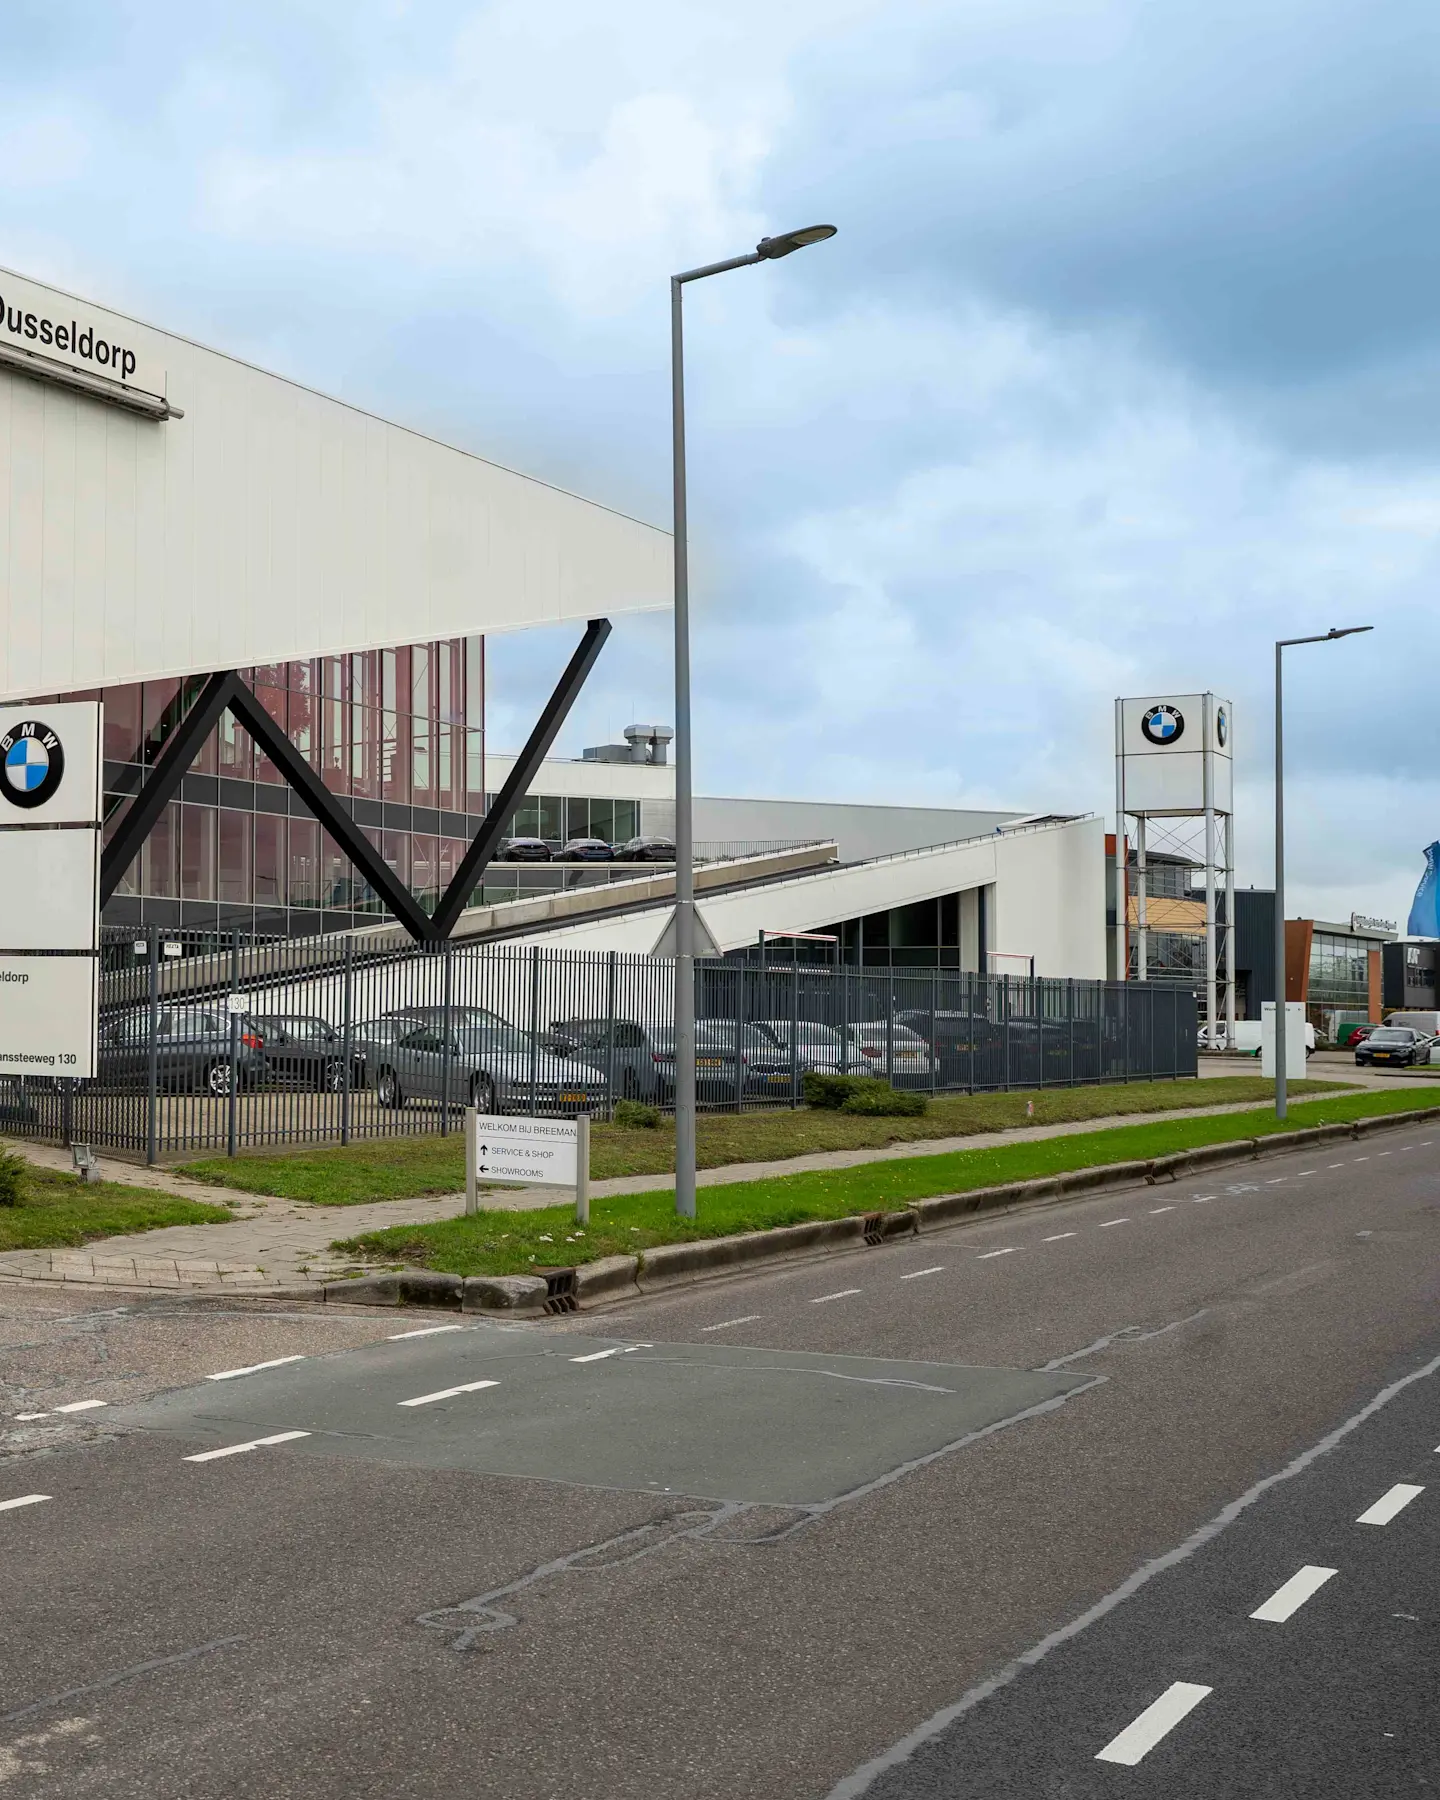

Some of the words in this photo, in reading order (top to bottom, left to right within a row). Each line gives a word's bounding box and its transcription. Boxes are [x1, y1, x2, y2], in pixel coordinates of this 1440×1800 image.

[1145, 705, 1181, 720] BMW
[0, 722, 59, 752] BMW
[230, 997, 246, 1010] 130
[58, 1053, 77, 1065] 130
[479, 1122, 517, 1133] WELKOM
[518, 1125, 532, 1134] BIJ
[533, 1126, 577, 1137] BREEMAN
[491, 1147, 524, 1157] SERVICE
[524, 1149, 531, 1157] &
[531, 1150, 554, 1159] SHOP
[491, 1166, 544, 1178] SHOWROOMS
